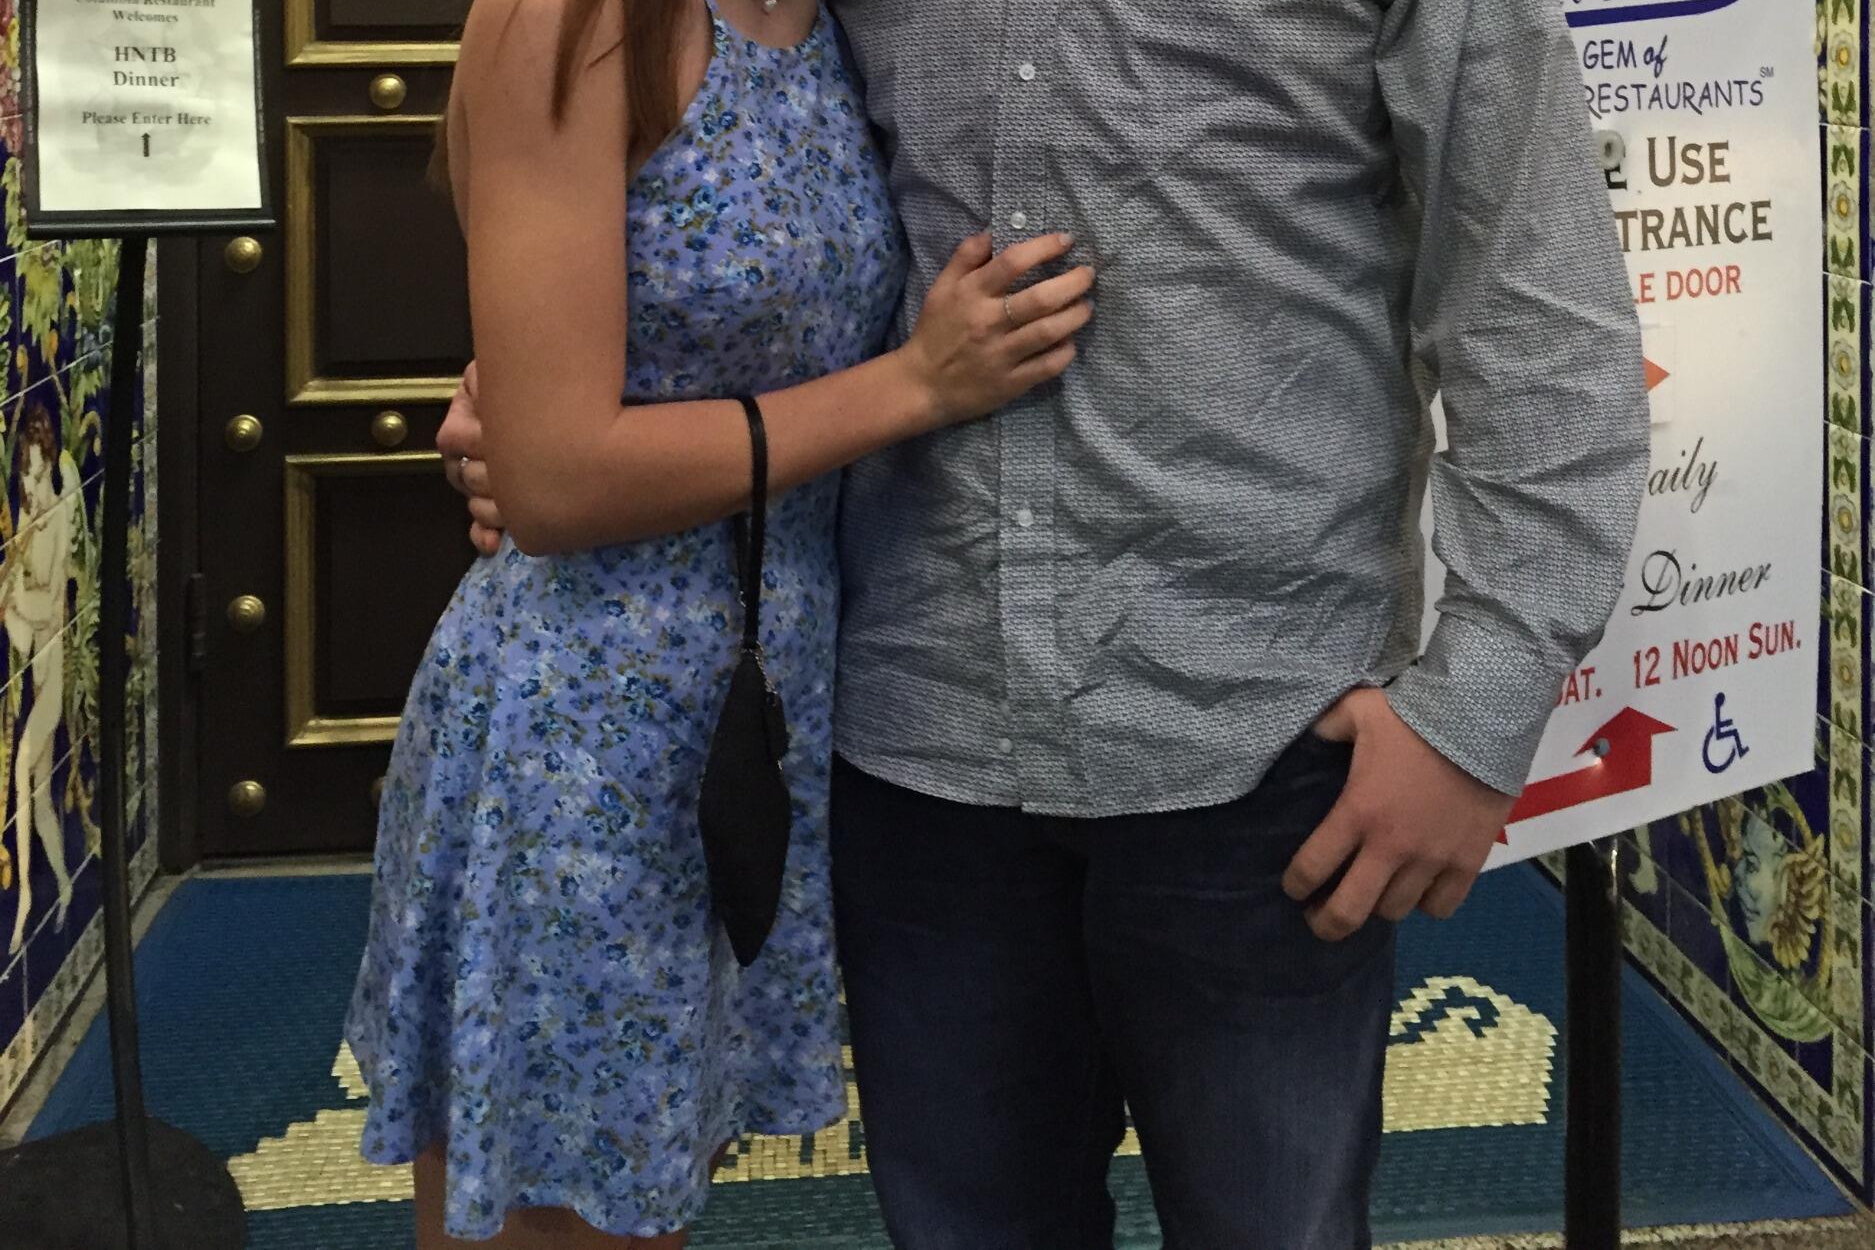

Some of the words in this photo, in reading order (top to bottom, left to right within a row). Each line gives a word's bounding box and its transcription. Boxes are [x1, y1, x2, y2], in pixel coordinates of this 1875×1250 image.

[112, 9, 179, 23] Welcomes
[114, 46, 177, 63] HNTB
[1582, 38, 1637, 70] GEM
[1643, 35, 1668, 78] of
[113, 70, 180, 87] Dinner
[82, 111, 127, 125] Please
[131, 112, 173, 125] Enter
[177, 113, 212, 125] Here
[1584, 80, 1764, 120] RESTAURANTS
[1646, 135, 1732, 188] USE
[1614, 198, 1773, 252] TRANCE
[1666, 264, 1742, 301] DOOR
[1648, 436, 1719, 514] aily
[1630, 549, 1773, 617] Dinner
[1633, 646, 1661, 689] 12
[1672, 634, 1740, 681] NOON
[1748, 619, 1803, 660] SUN.
